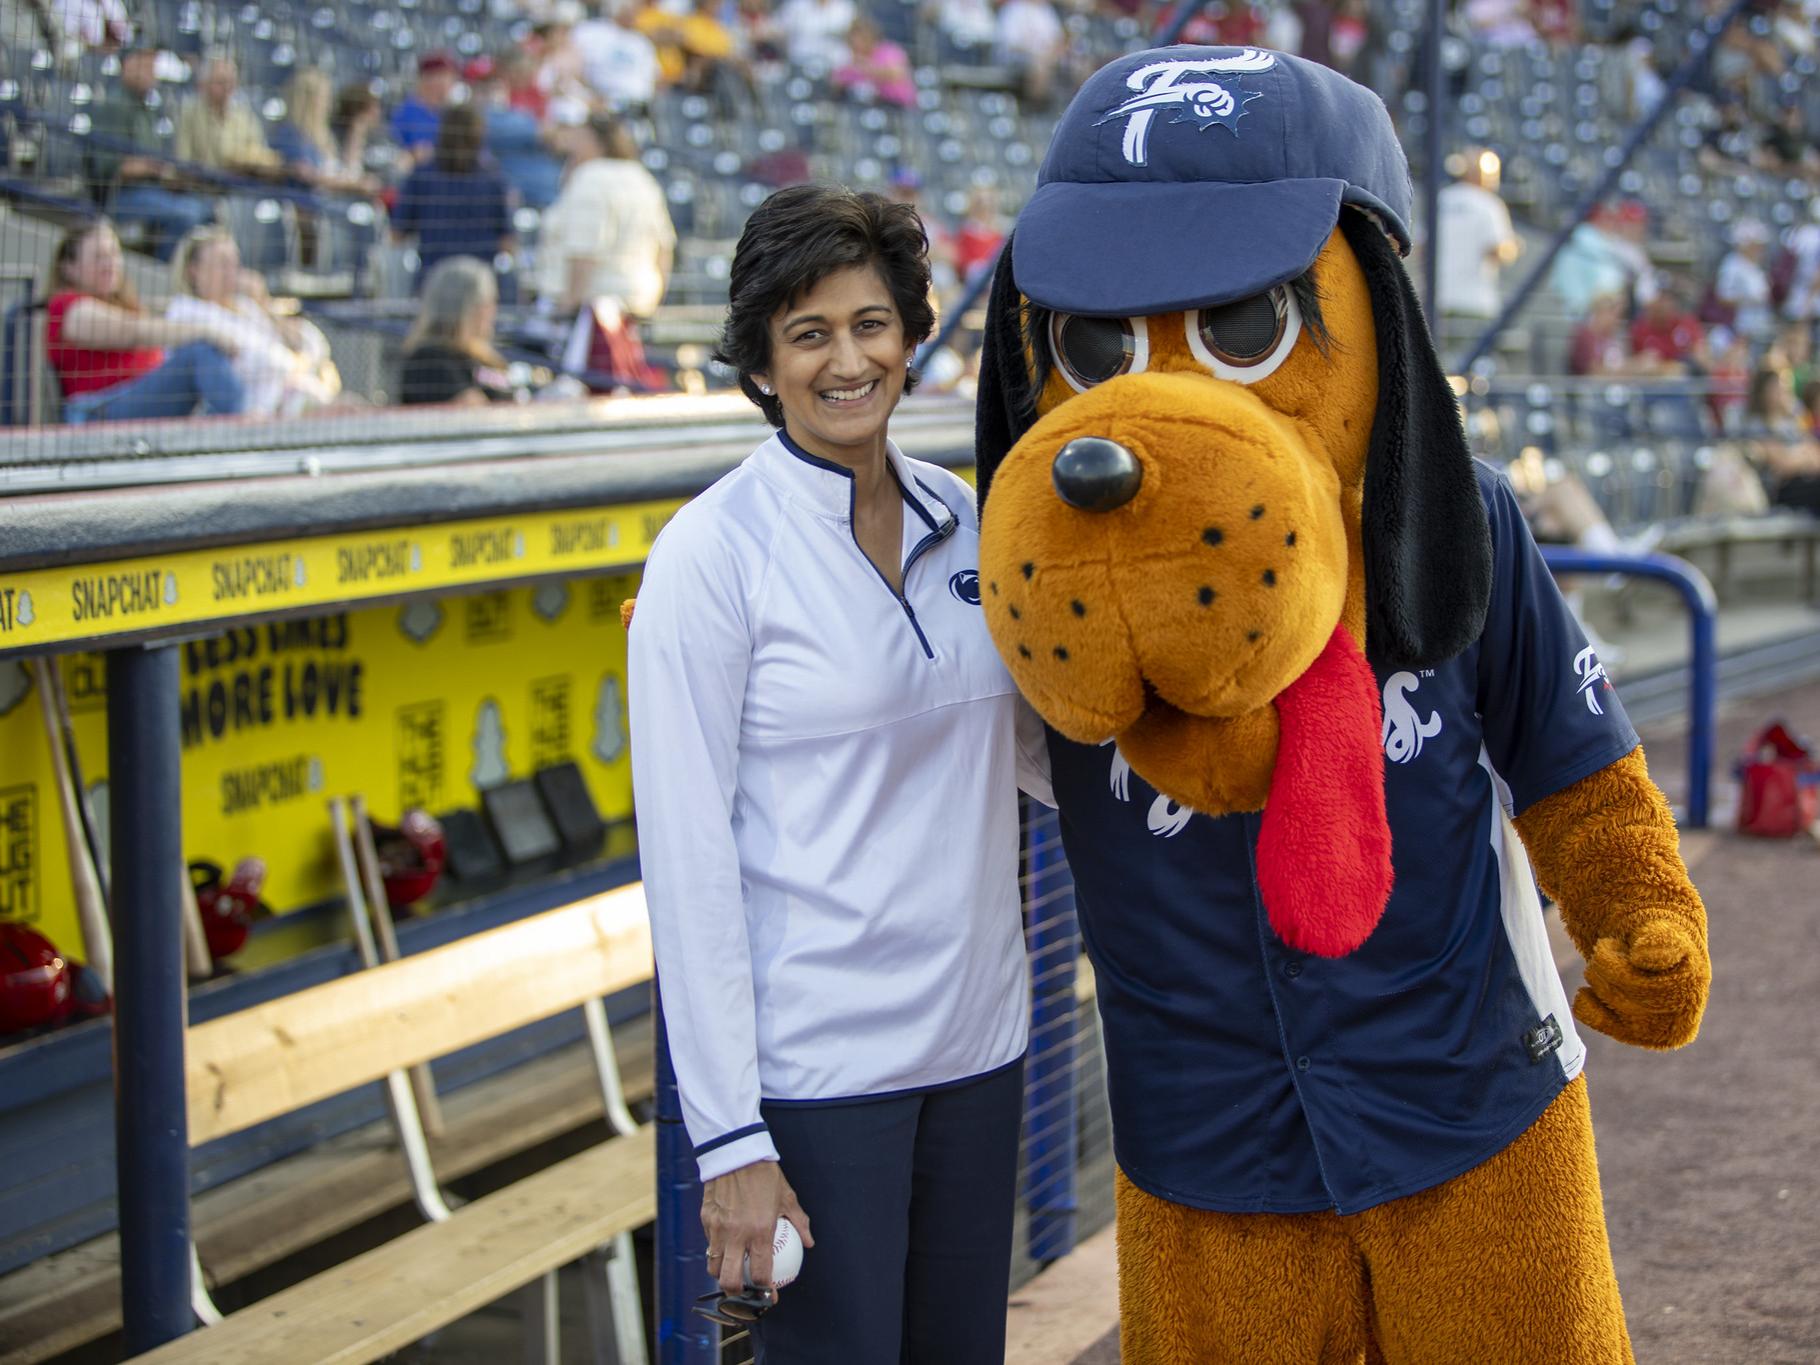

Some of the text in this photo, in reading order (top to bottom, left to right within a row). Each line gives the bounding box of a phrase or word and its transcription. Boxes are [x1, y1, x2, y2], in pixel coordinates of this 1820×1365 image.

[213, 554, 292, 601] SNAPCHAT
[337, 539, 408, 583] SNAPCHAT
[72, 570, 161, 621] SNAPCHAT
[1419, 669, 1435, 678] TM
[181, 669, 274, 748] MORE
[284, 660, 363, 720] LOVE
